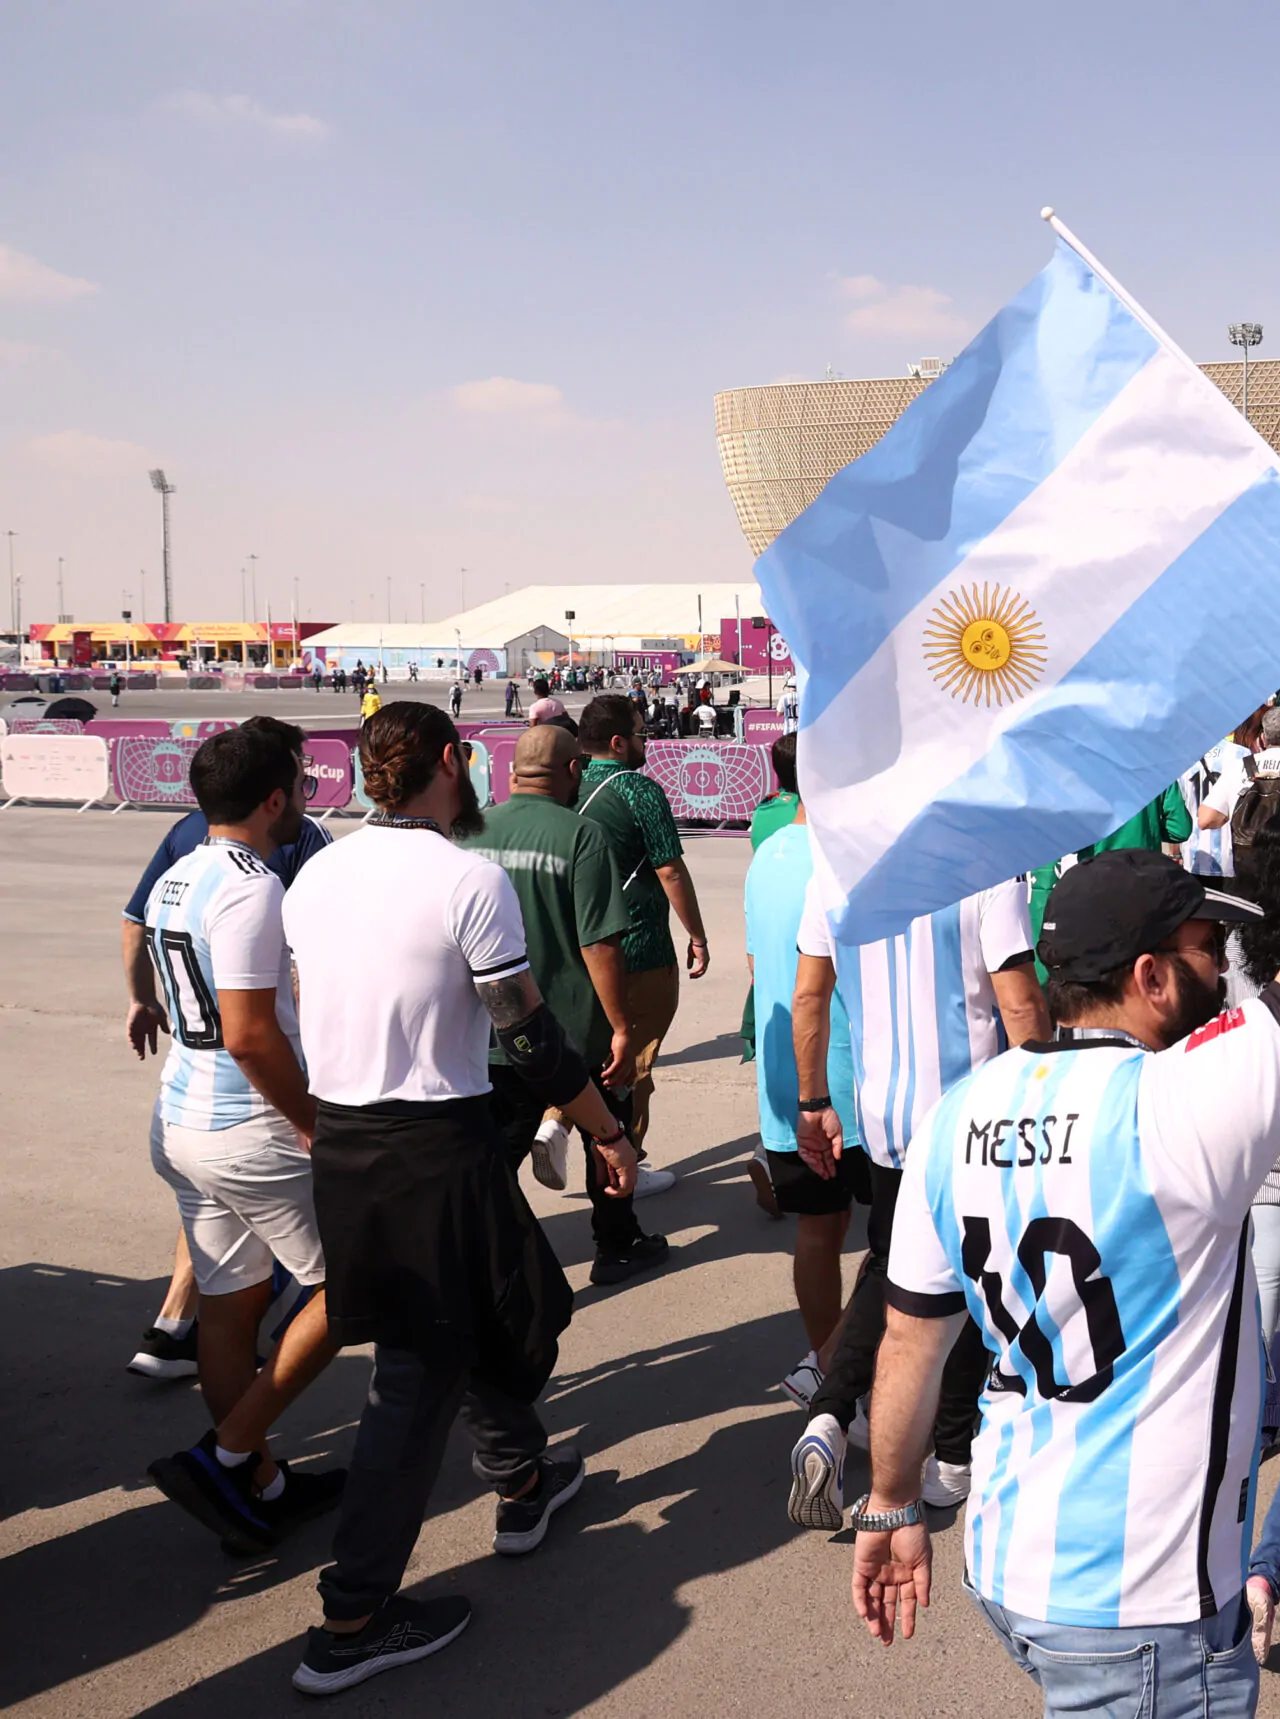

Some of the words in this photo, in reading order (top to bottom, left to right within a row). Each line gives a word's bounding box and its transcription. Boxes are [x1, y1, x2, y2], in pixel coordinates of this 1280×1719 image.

[748, 723, 784, 731] #FIFAW
[304, 764, 345, 783] ldCup
[965, 1113, 1080, 1168] MESSI
[961, 1215, 1127, 1403] 10
